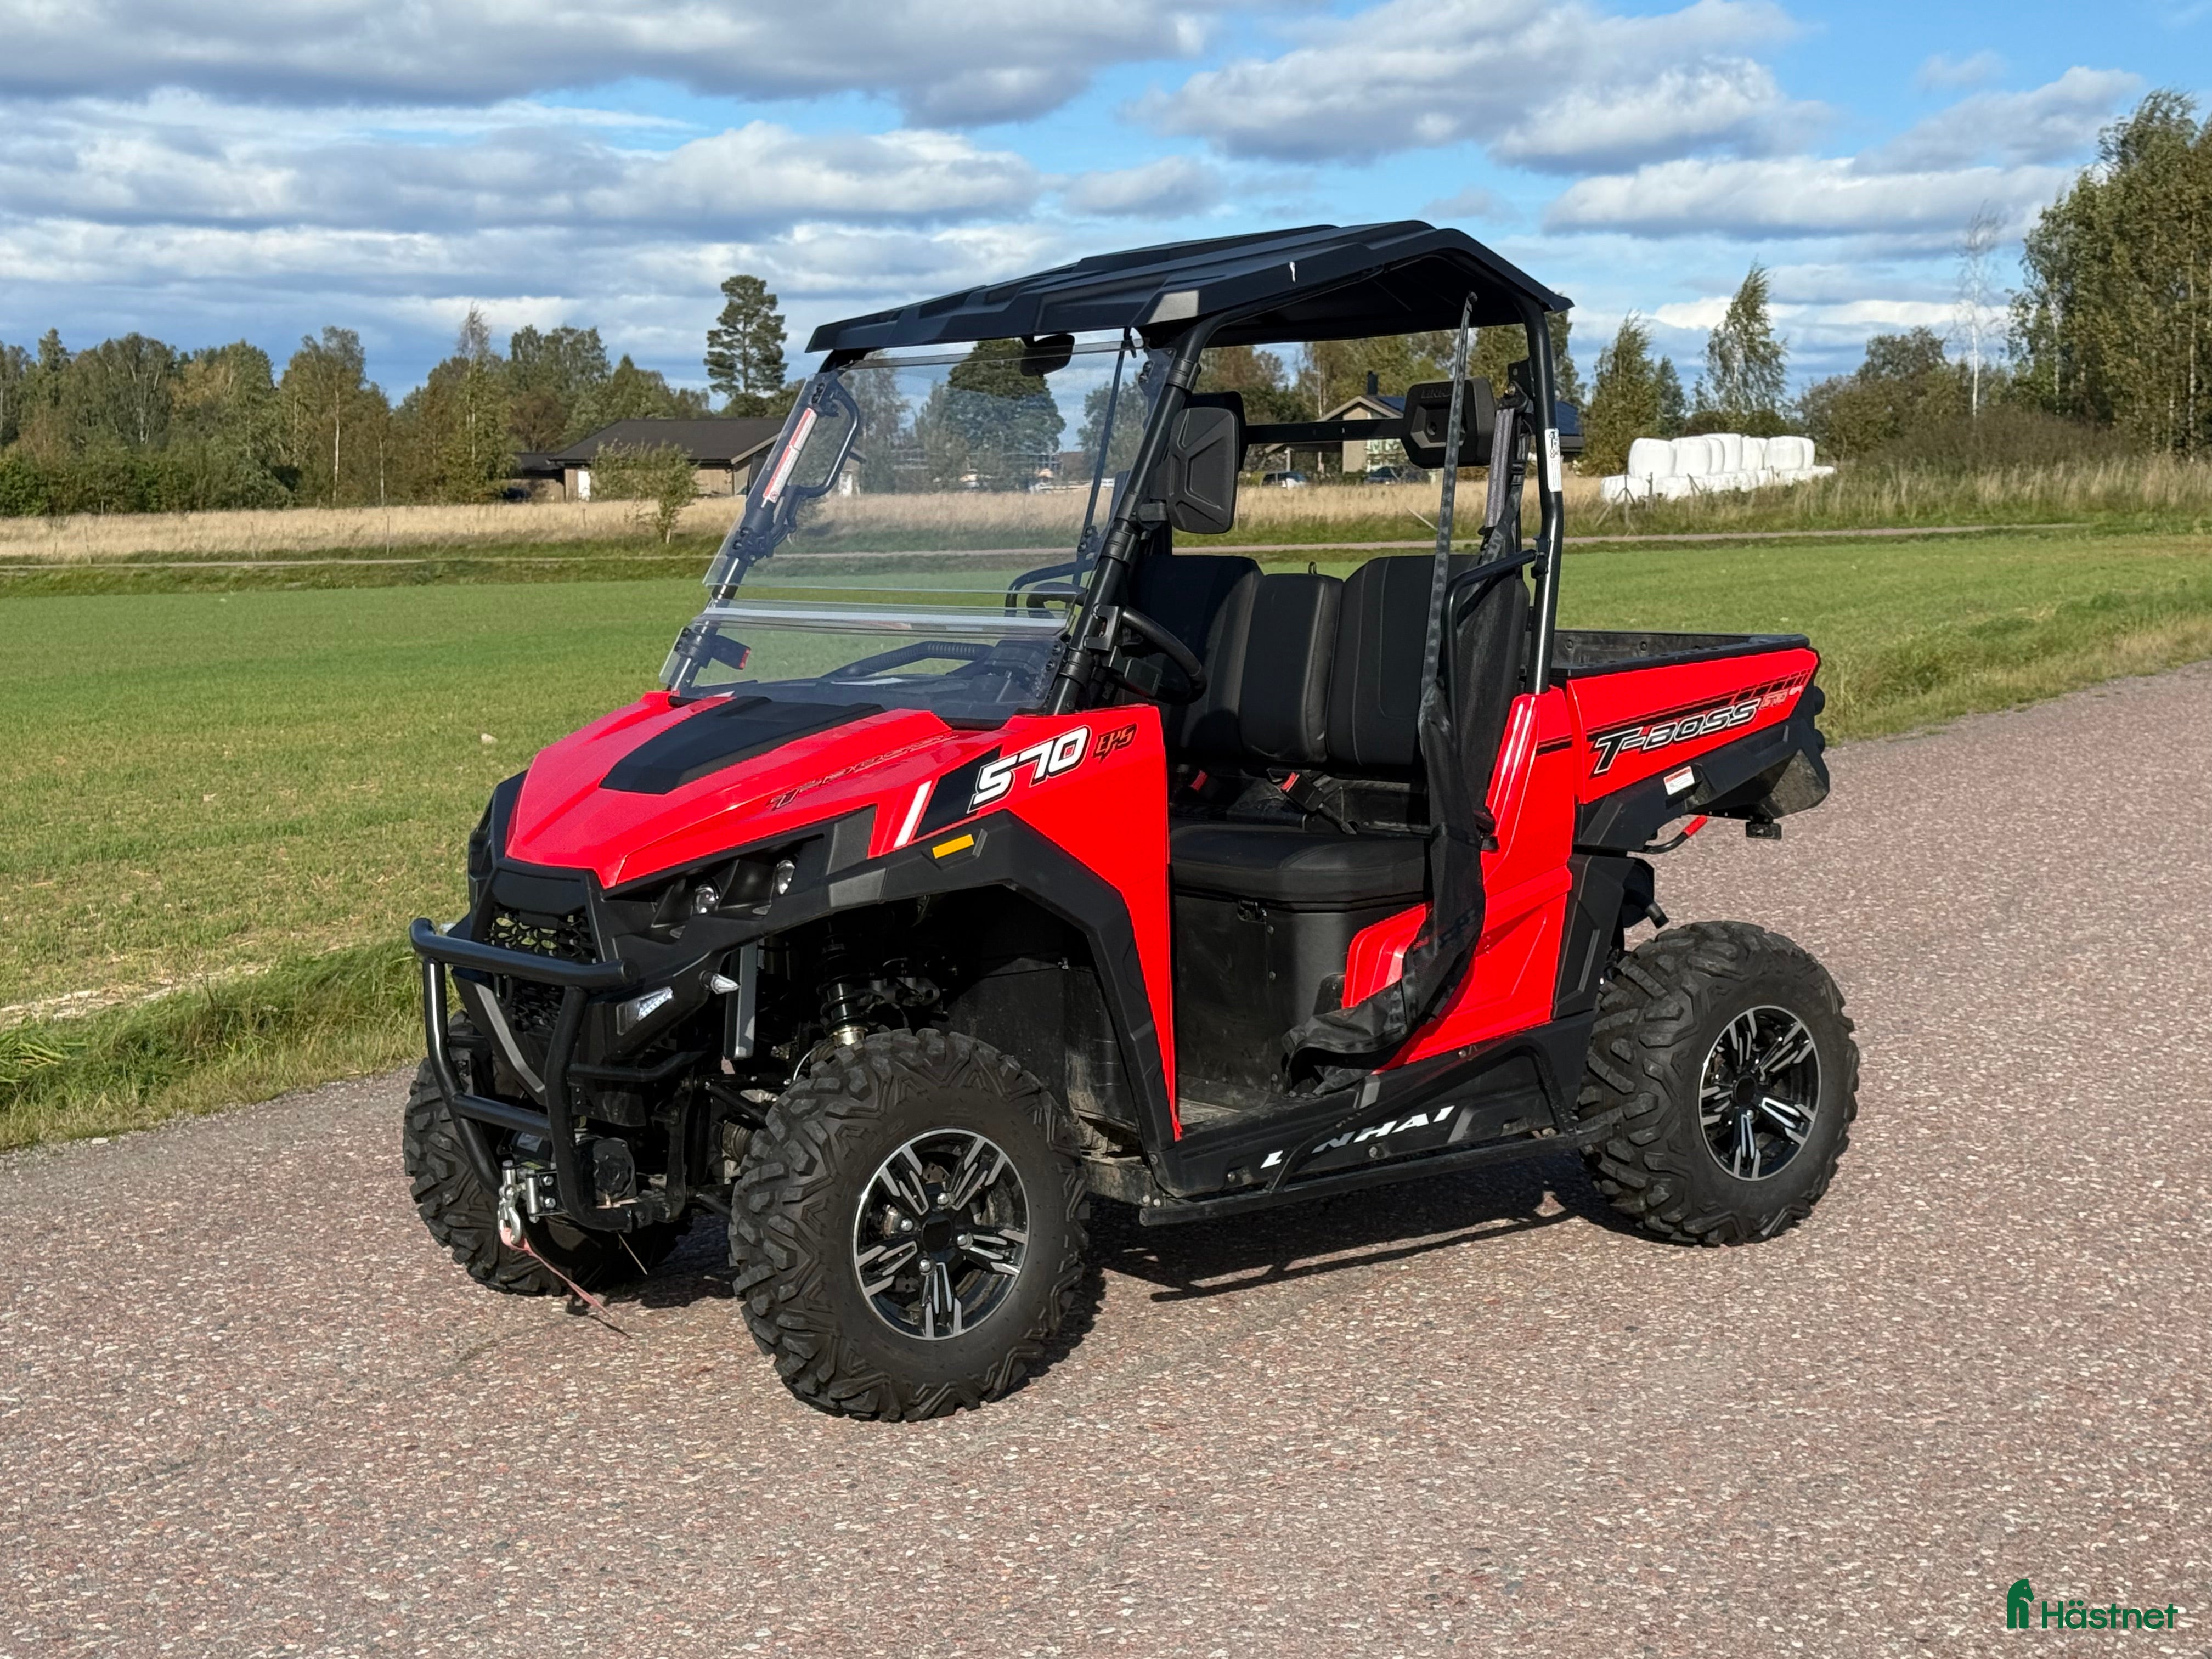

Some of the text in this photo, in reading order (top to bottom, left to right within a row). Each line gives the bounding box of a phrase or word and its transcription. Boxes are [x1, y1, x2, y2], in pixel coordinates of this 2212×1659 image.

[967, 725, 1091, 812] 570
[1593, 697, 1762, 775] T-BOSS
[1260, 1105, 1455, 1169] LNHAI
